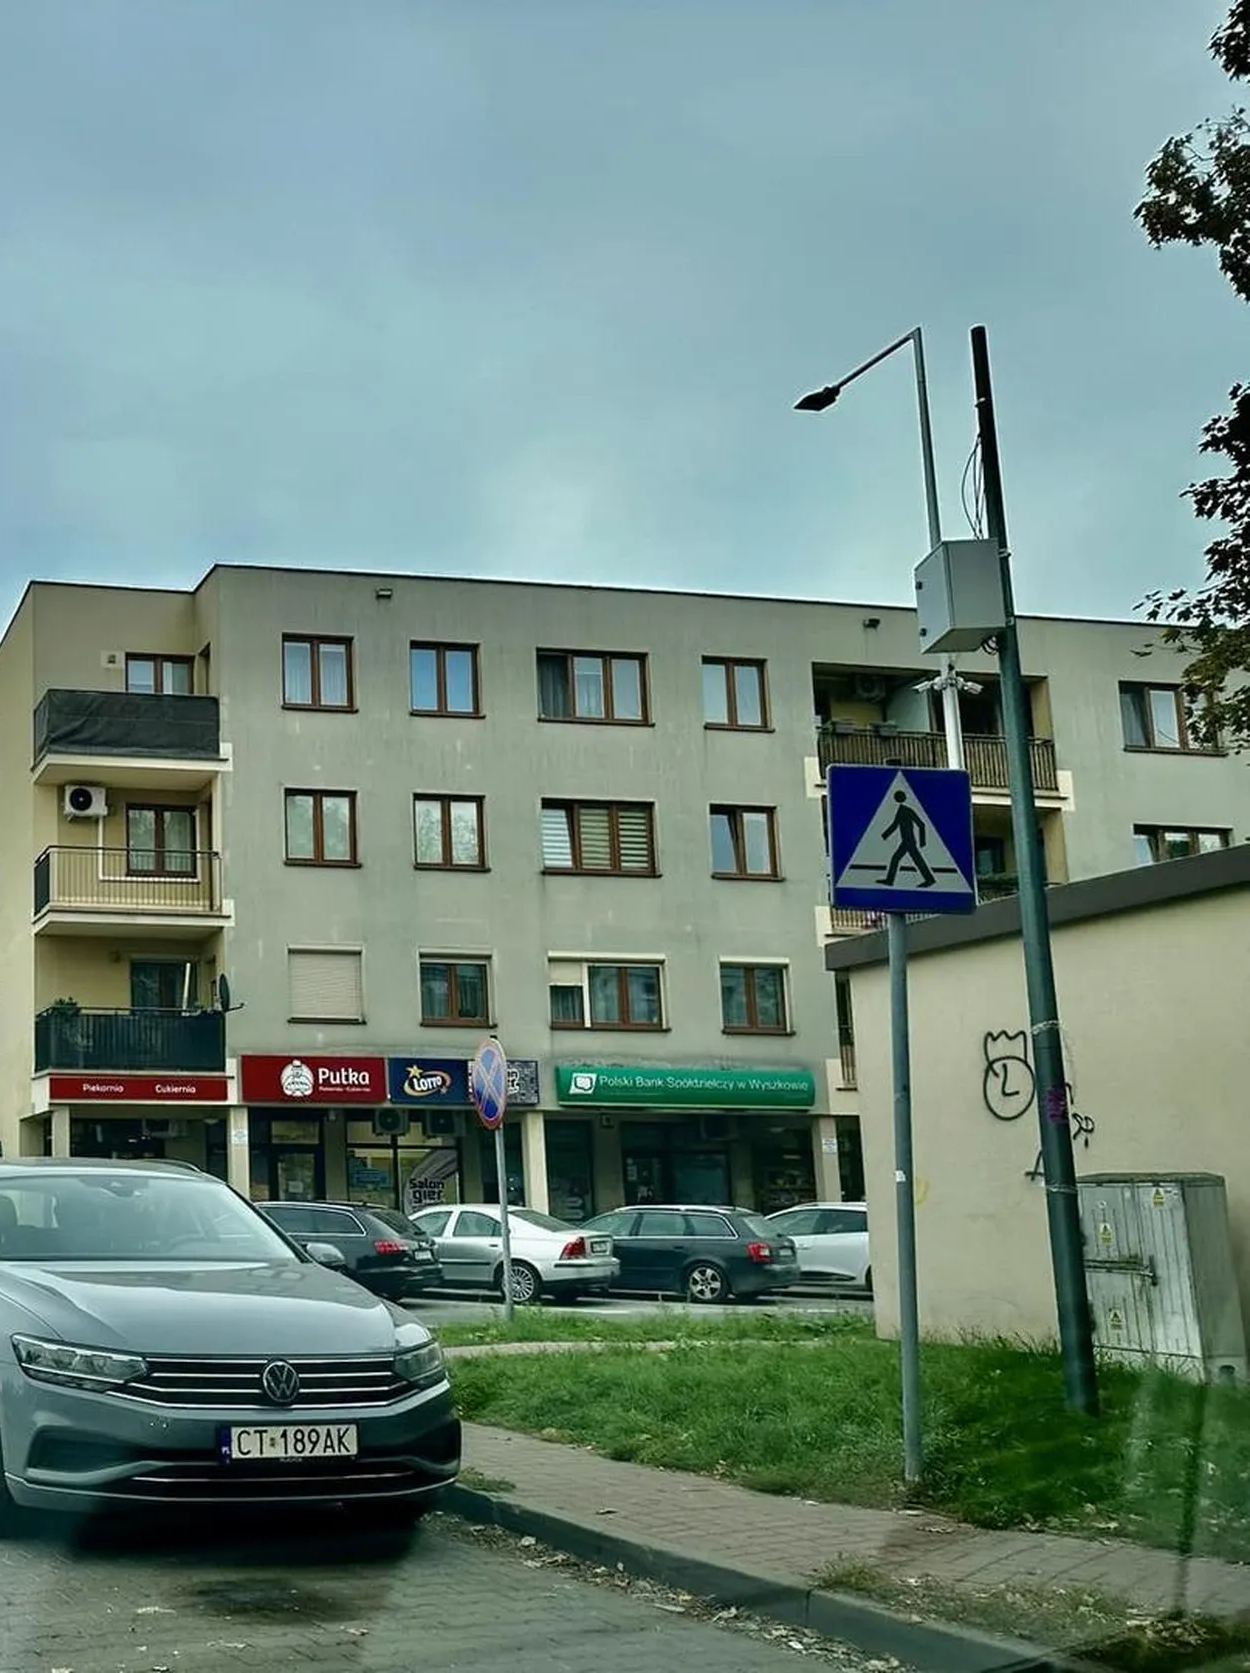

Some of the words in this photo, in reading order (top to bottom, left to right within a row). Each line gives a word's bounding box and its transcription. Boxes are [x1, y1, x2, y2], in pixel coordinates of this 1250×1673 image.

[318, 1067, 370, 1085] Putka
[413, 1075, 442, 1091] LOTTO
[599, 1075, 633, 1088] Polski
[635, 1076, 664, 1088] Bank
[736, 1081, 746, 1089] w
[155, 1083, 197, 1094] Cukiernia
[236, 1429, 268, 1456] CT
[280, 1427, 351, 1455] 189AK
